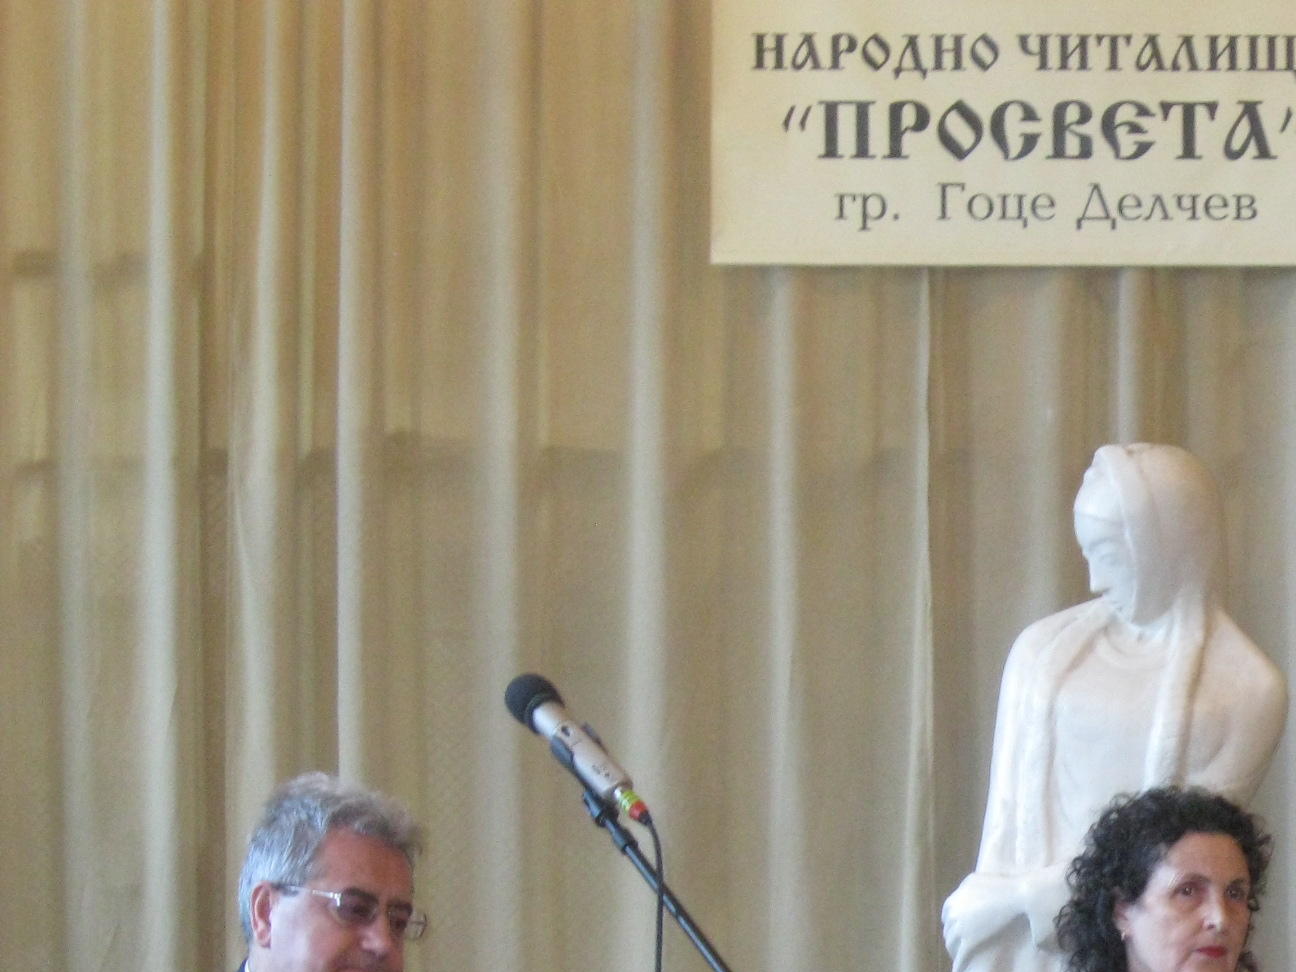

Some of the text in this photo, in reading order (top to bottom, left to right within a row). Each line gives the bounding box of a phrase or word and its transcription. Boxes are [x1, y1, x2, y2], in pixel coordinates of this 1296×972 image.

[752, 32, 1000, 81] НАРОДНО
[835, 182, 1258, 232] гр. Гоце Делчев
